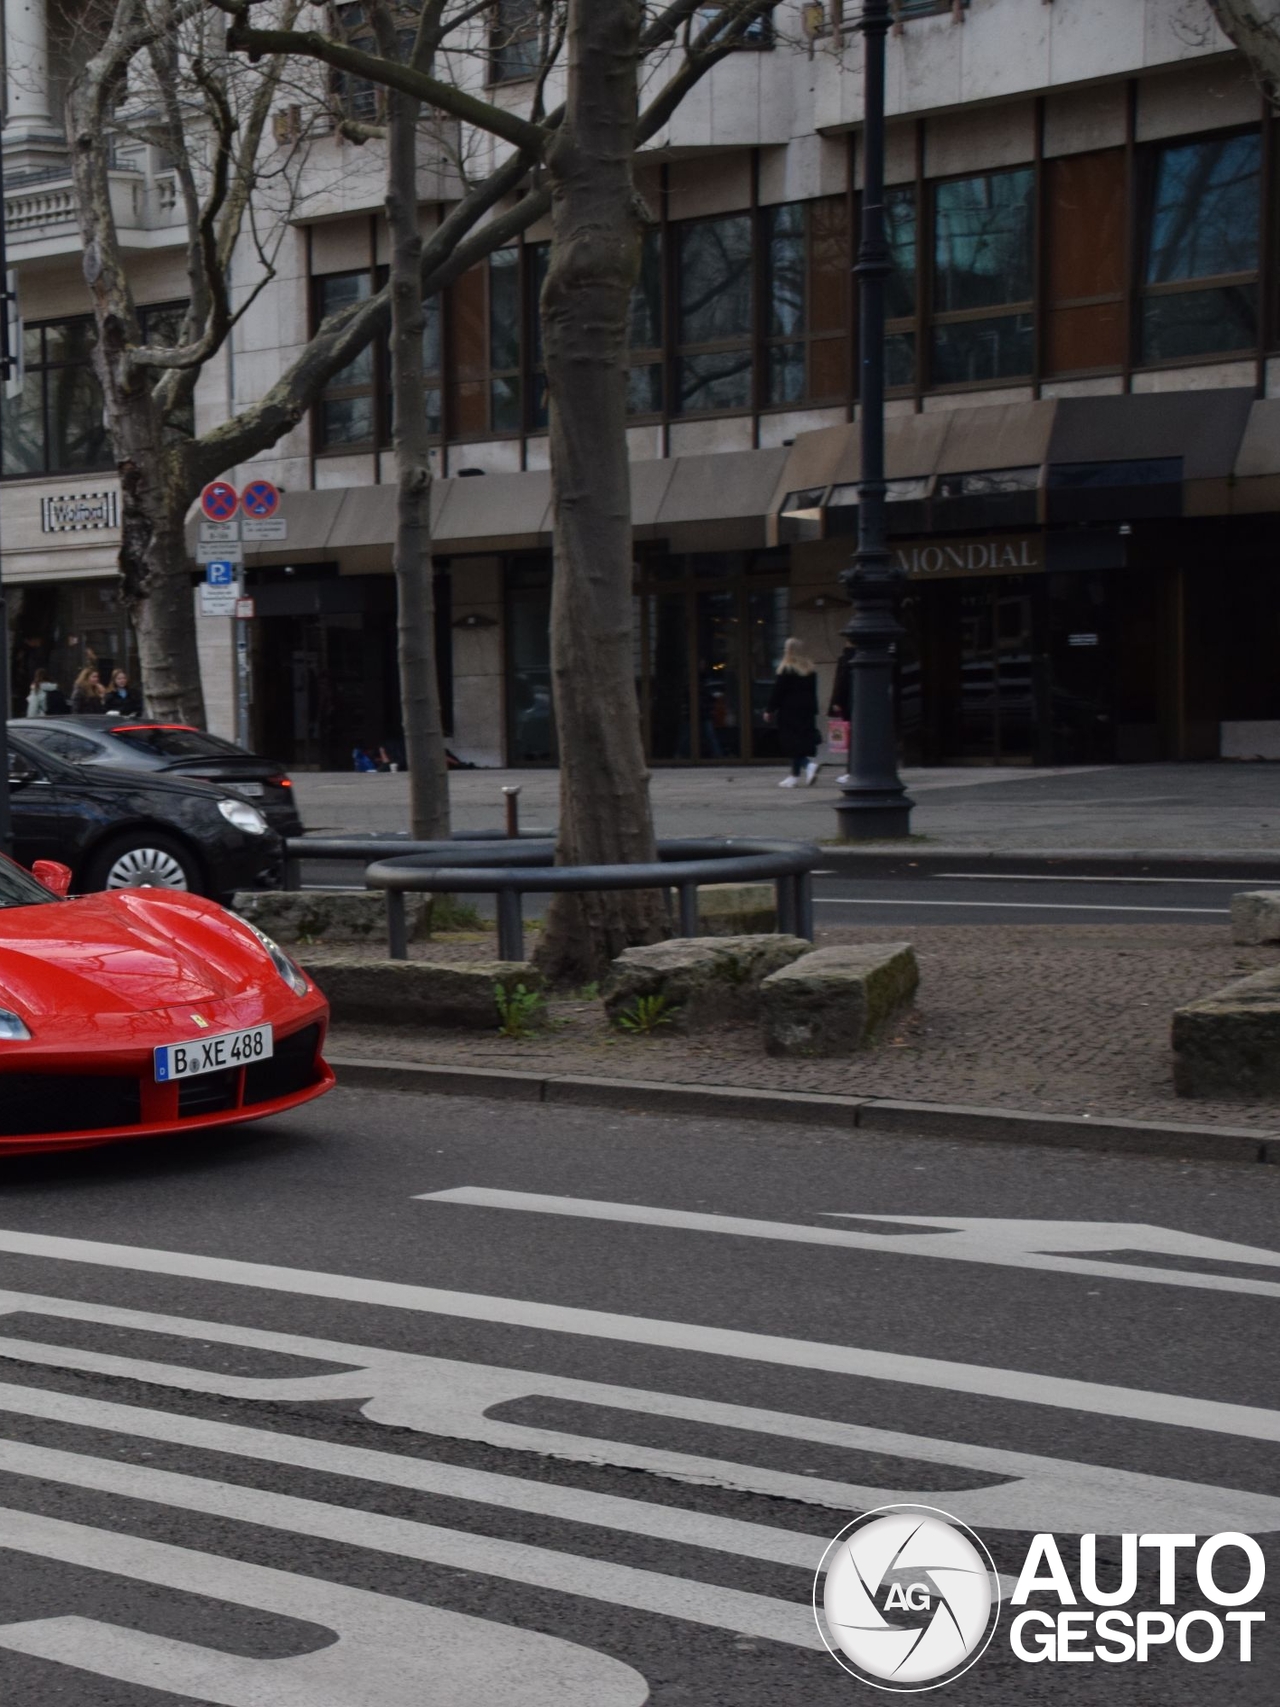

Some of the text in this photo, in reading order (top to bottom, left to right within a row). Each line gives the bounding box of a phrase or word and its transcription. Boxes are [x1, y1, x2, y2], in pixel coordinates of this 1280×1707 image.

[54, 502, 104, 523] Wolford
[896, 541, 1038, 573] MONDIAL
[211, 564, 225, 582] P
[174, 1031, 263, 1074] B XE 488
